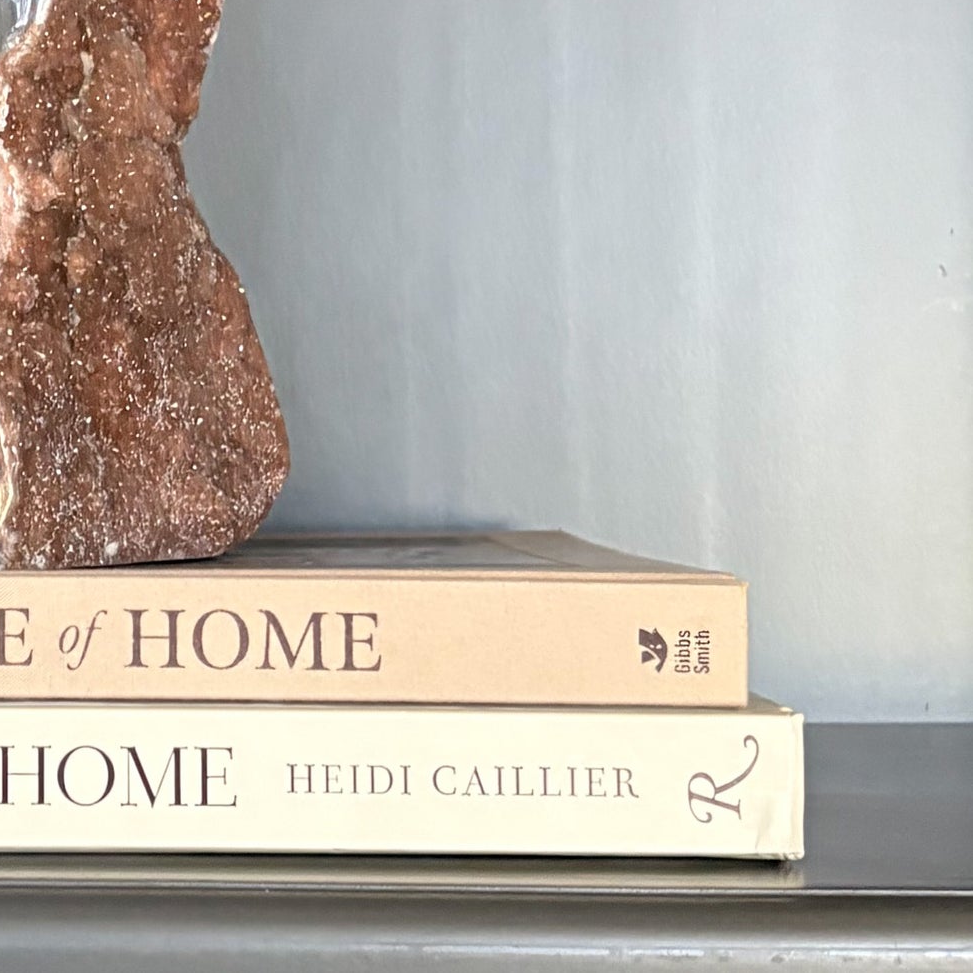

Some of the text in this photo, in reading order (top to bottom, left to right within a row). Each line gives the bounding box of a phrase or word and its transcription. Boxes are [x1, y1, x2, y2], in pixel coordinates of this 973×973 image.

[58, 609, 108, 671] of
[123, 608, 382, 672] HOME
[674, 630, 691, 674] Gibbs
[693, 630, 711, 674] Smith
[286, 763, 640, 799] HEIDI CAILLIER
